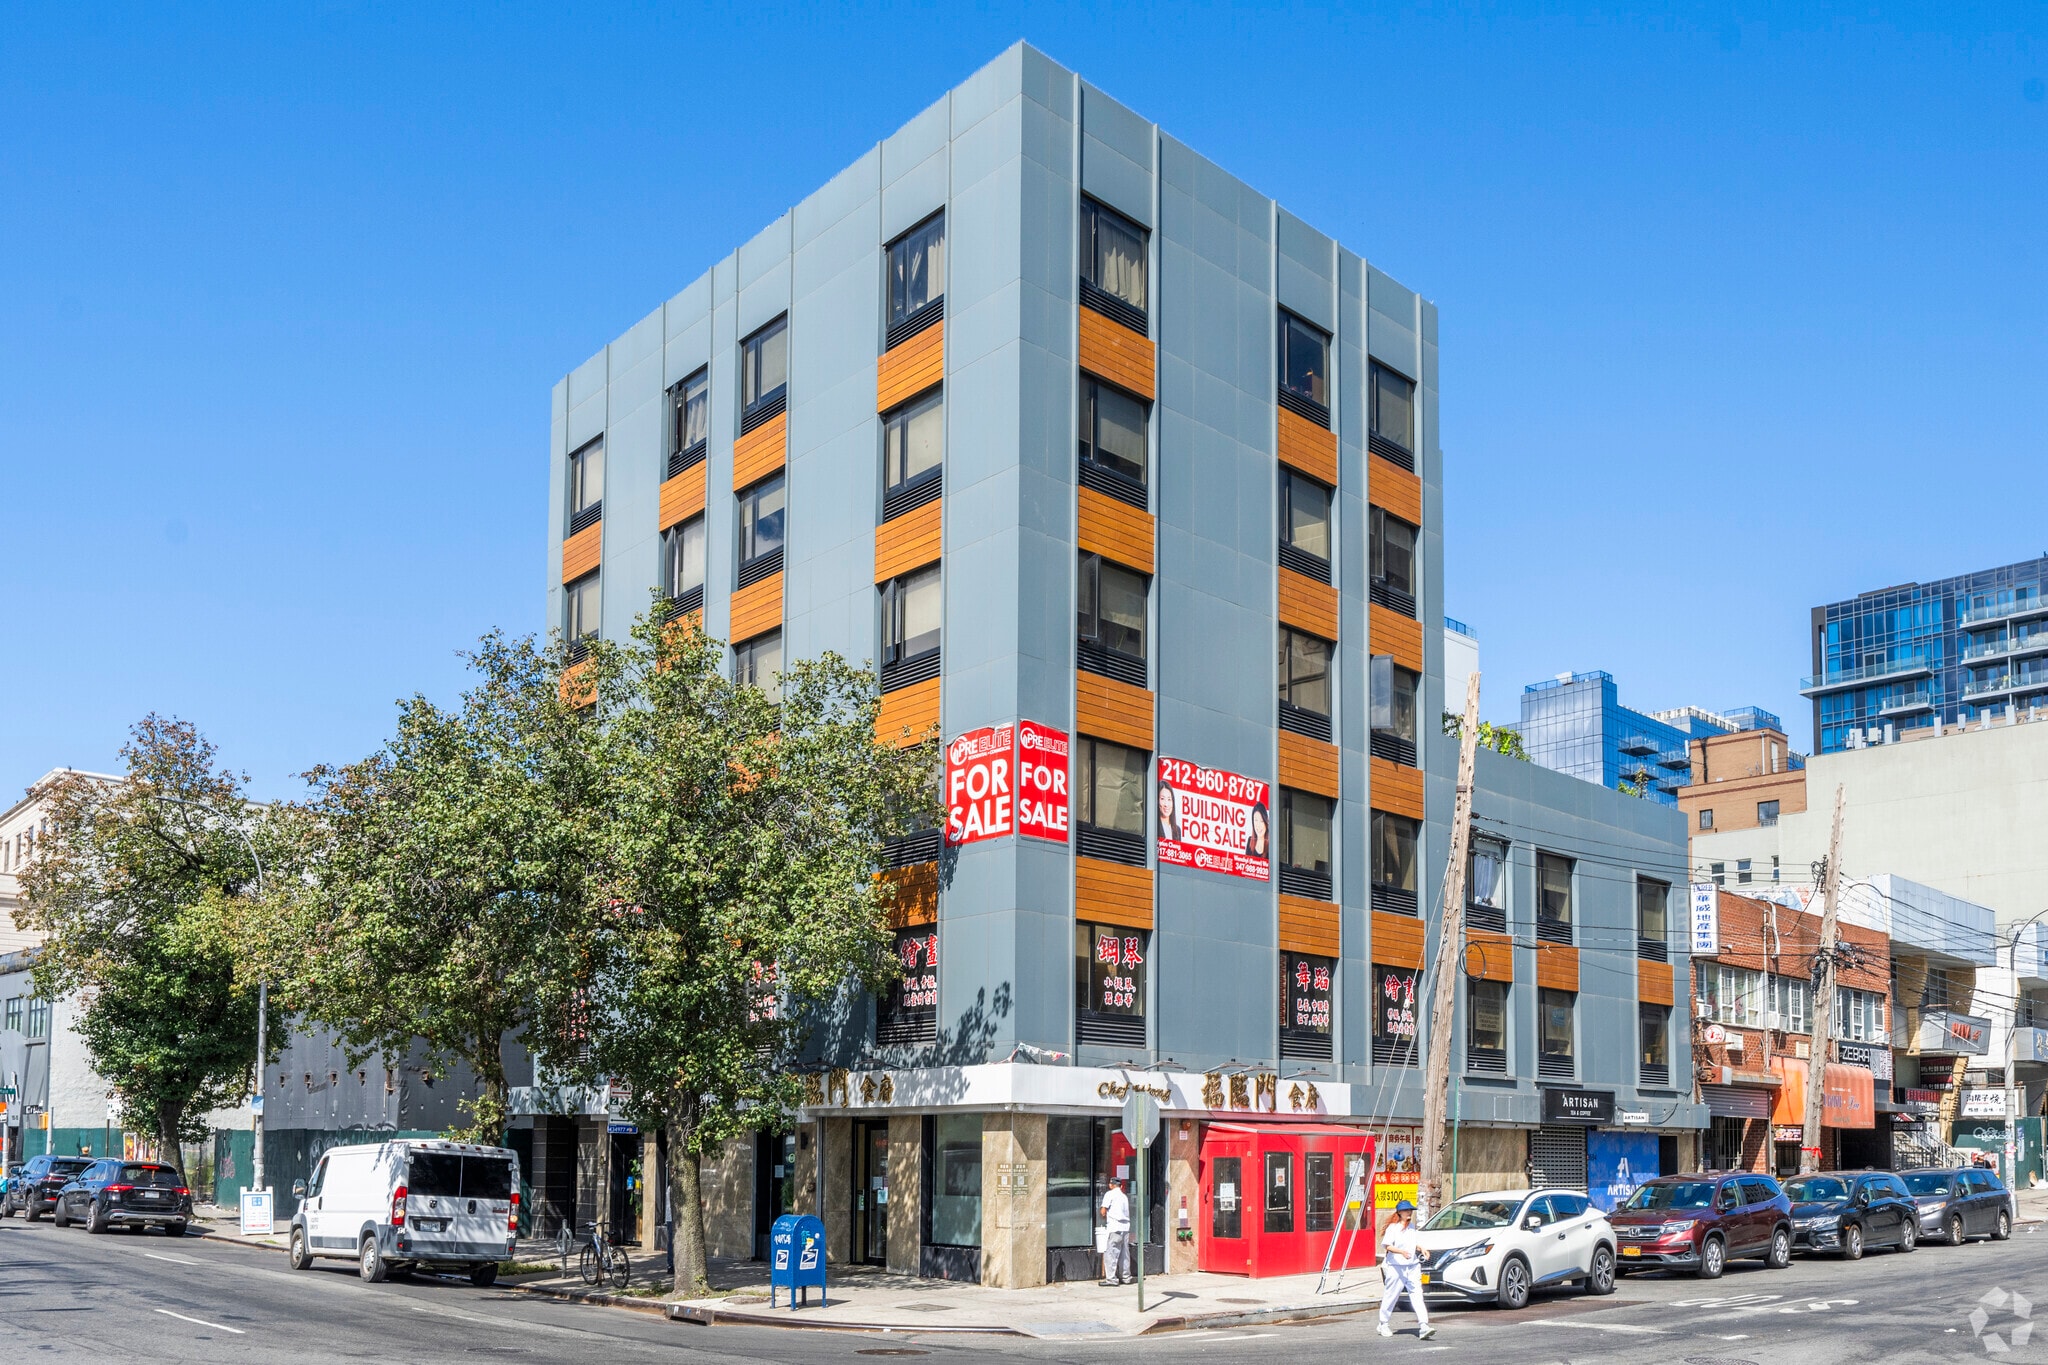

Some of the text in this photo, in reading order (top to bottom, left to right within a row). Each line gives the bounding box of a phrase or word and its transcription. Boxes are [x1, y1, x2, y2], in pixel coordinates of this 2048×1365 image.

[958, 729, 1011, 757] PRE ELITE
[1028, 733, 1043, 746] PRE
[1044, 737, 1067, 753] ELITE
[951, 759, 1009, 805] FOR
[1021, 761, 1067, 795] FOR
[950, 795, 1010, 841] SALE
[1020, 798, 1067, 831] SALE
[1182, 796, 1246, 827] BUILDING
[1182, 818, 1246, 850] FOR SALE
[1097, 934, 1143, 970] 鋼琴
[1296, 961, 1329, 992] 舞蹈
[1842, 1046, 1870, 1063] ZEBRA
[1097, 1081, 1130, 1100] Chef
[1562, 1094, 1599, 1108] ARTISAN
